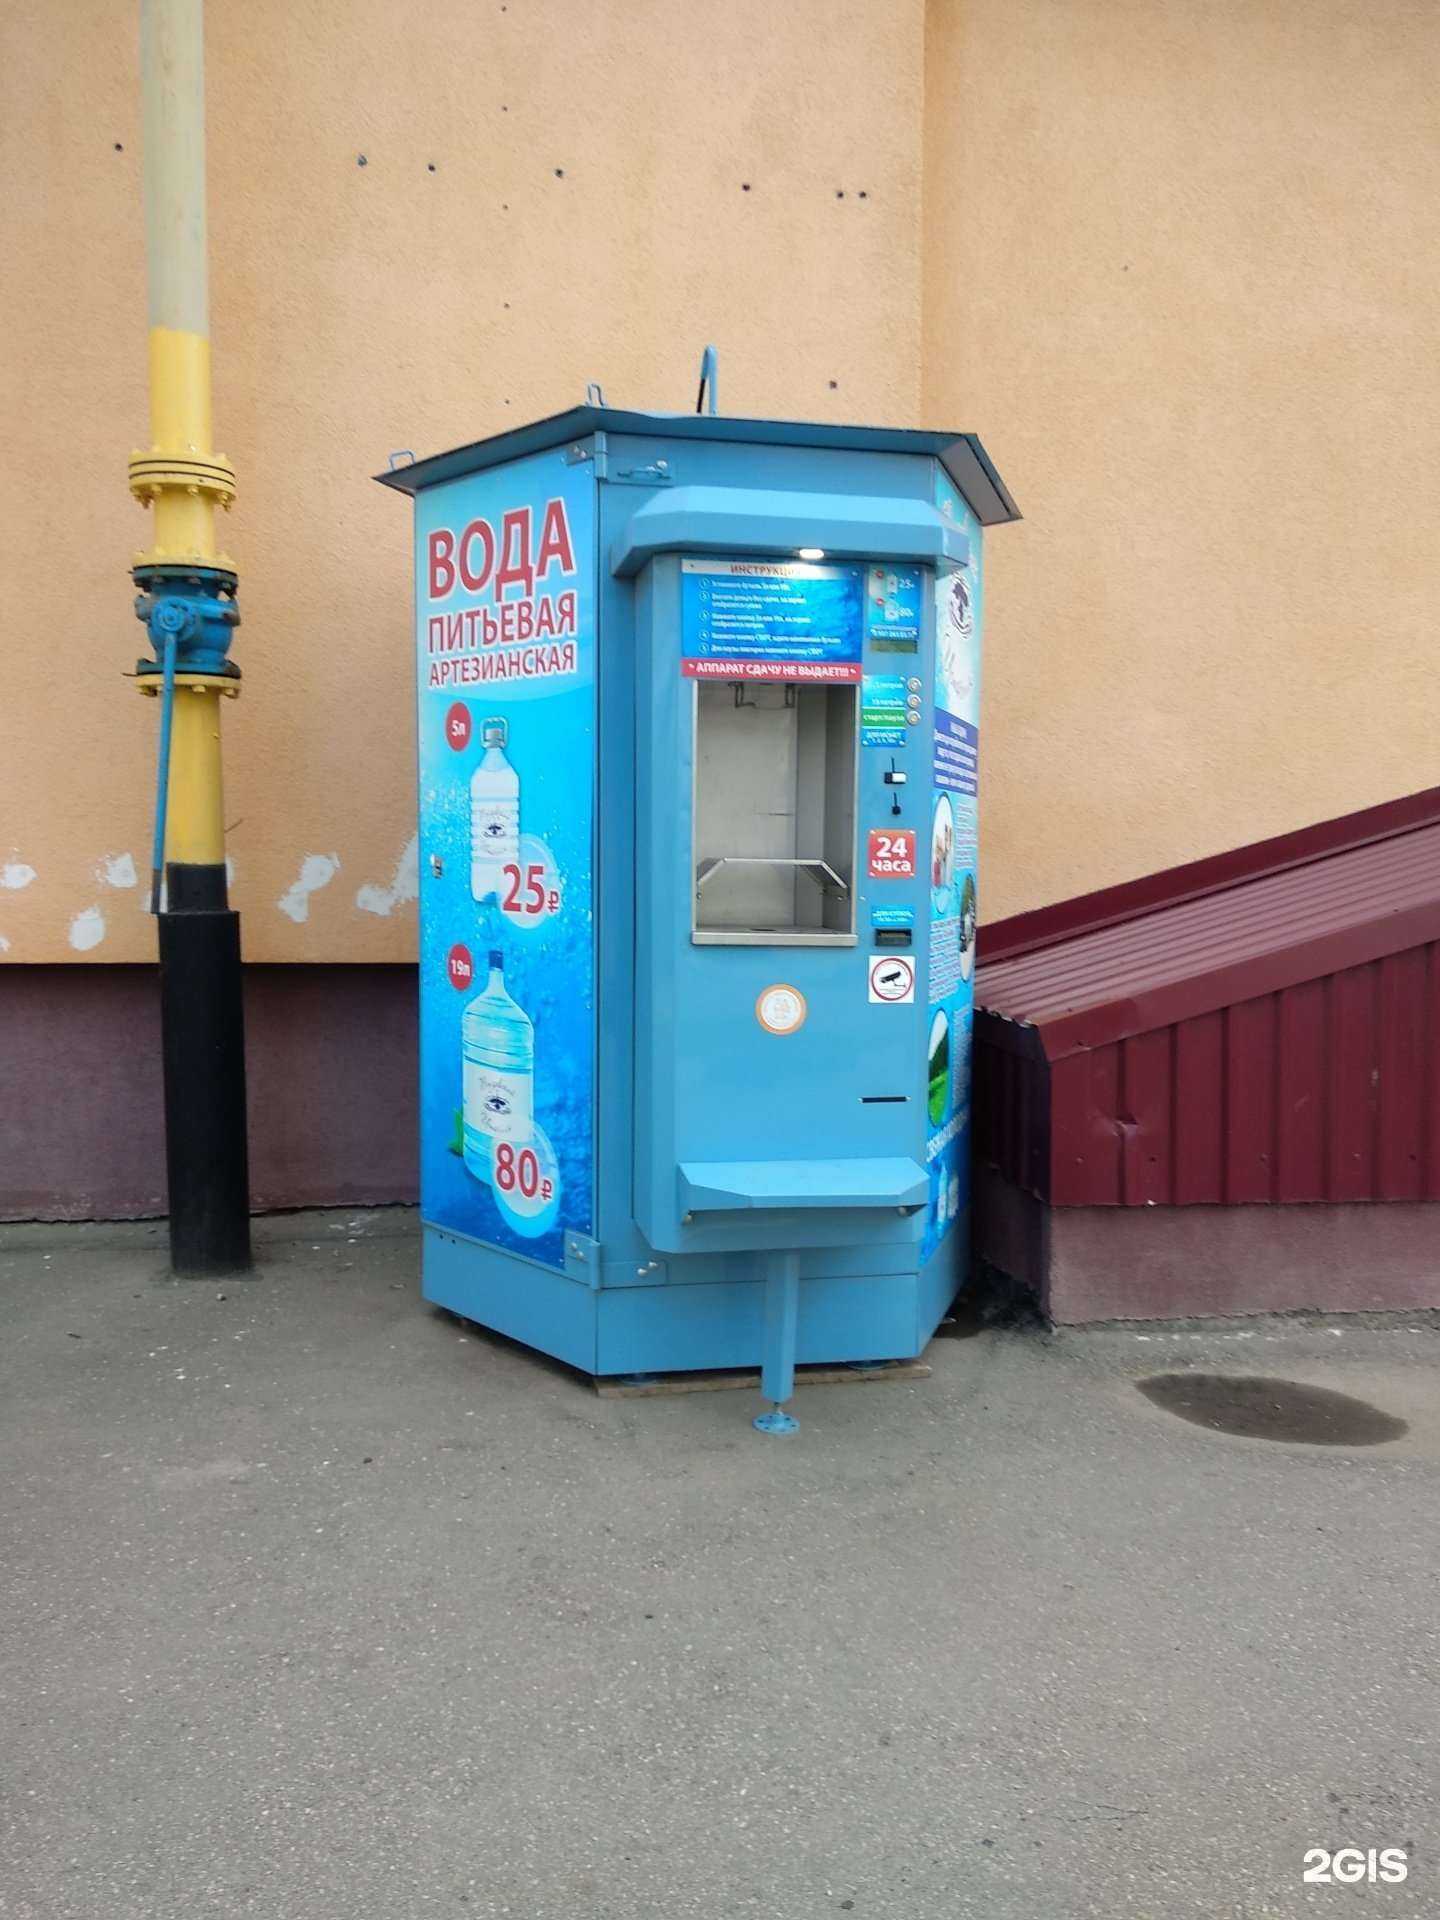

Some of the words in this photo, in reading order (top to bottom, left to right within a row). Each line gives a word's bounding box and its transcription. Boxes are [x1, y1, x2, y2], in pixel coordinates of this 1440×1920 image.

[429, 500, 574, 603] ВОДА
[429, 592, 575, 654] ПИТЬЕВАЯ
[429, 643, 575, 687] АРТЕЗИАНСКАЯ
[695, 662, 745, 674] АППАРАТ
[746, 664, 782, 676] СДАЧУ
[783, 665, 798, 676] НЕ
[876, 836, 908, 858] 24
[872, 859, 912, 873] часа
